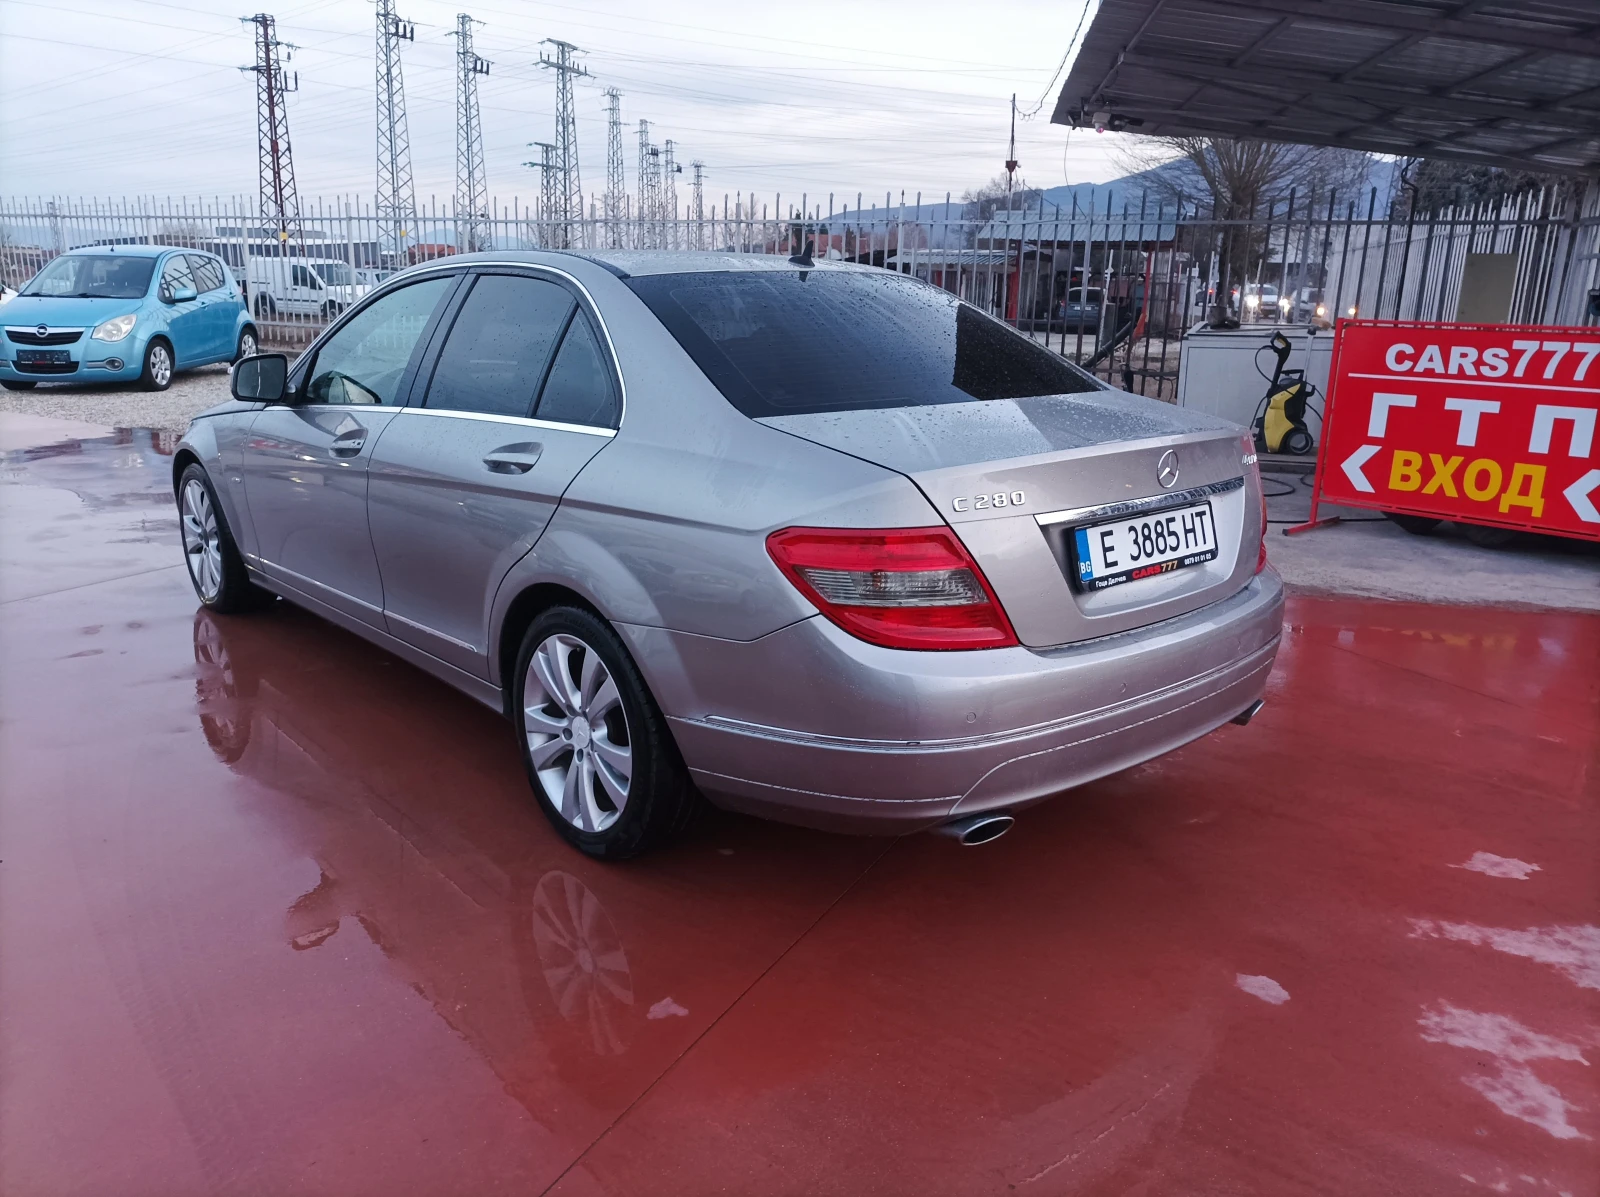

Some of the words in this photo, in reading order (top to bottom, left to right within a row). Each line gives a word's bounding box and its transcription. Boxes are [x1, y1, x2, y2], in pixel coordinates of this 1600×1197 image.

[1385, 340, 1600, 382] CARS777
[1388, 449, 1547, 518] ВХОД
[952, 496, 968, 512] C
[974, 490, 1026, 511] 280
[1100, 530, 1118, 569] E
[1128, 516, 1180, 562] 3885
[1181, 510, 1207, 549] HT
[1080, 561, 1092, 574] BG
[1132, 560, 1178, 580] CARS777
